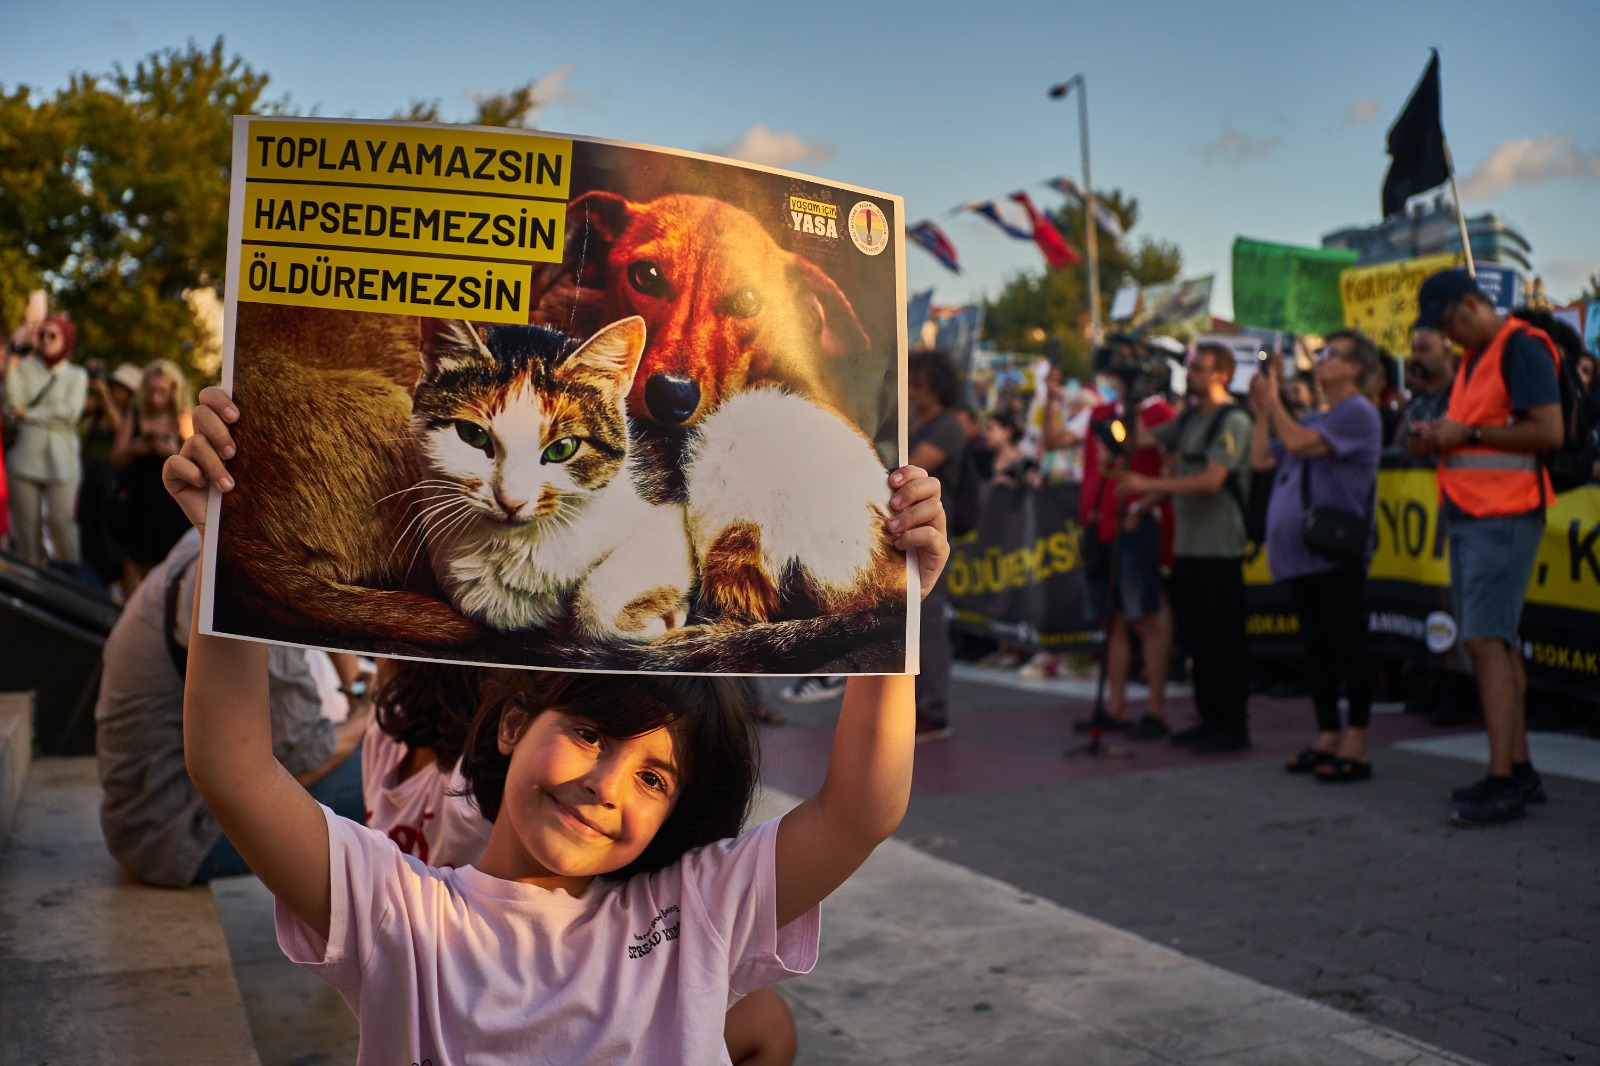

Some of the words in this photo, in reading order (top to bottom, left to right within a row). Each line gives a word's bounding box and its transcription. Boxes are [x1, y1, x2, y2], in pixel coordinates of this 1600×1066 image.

[255, 135, 563, 187] TOPLAYAMAZSIN
[254, 198, 556, 250] HAPSEDEMEZSİN
[791, 197, 821, 214] yaşam
[791, 211, 838, 239] YASA
[248, 251, 522, 312] ÖLDÜREMEZSİN
[628, 932, 661, 959] SPREAD
